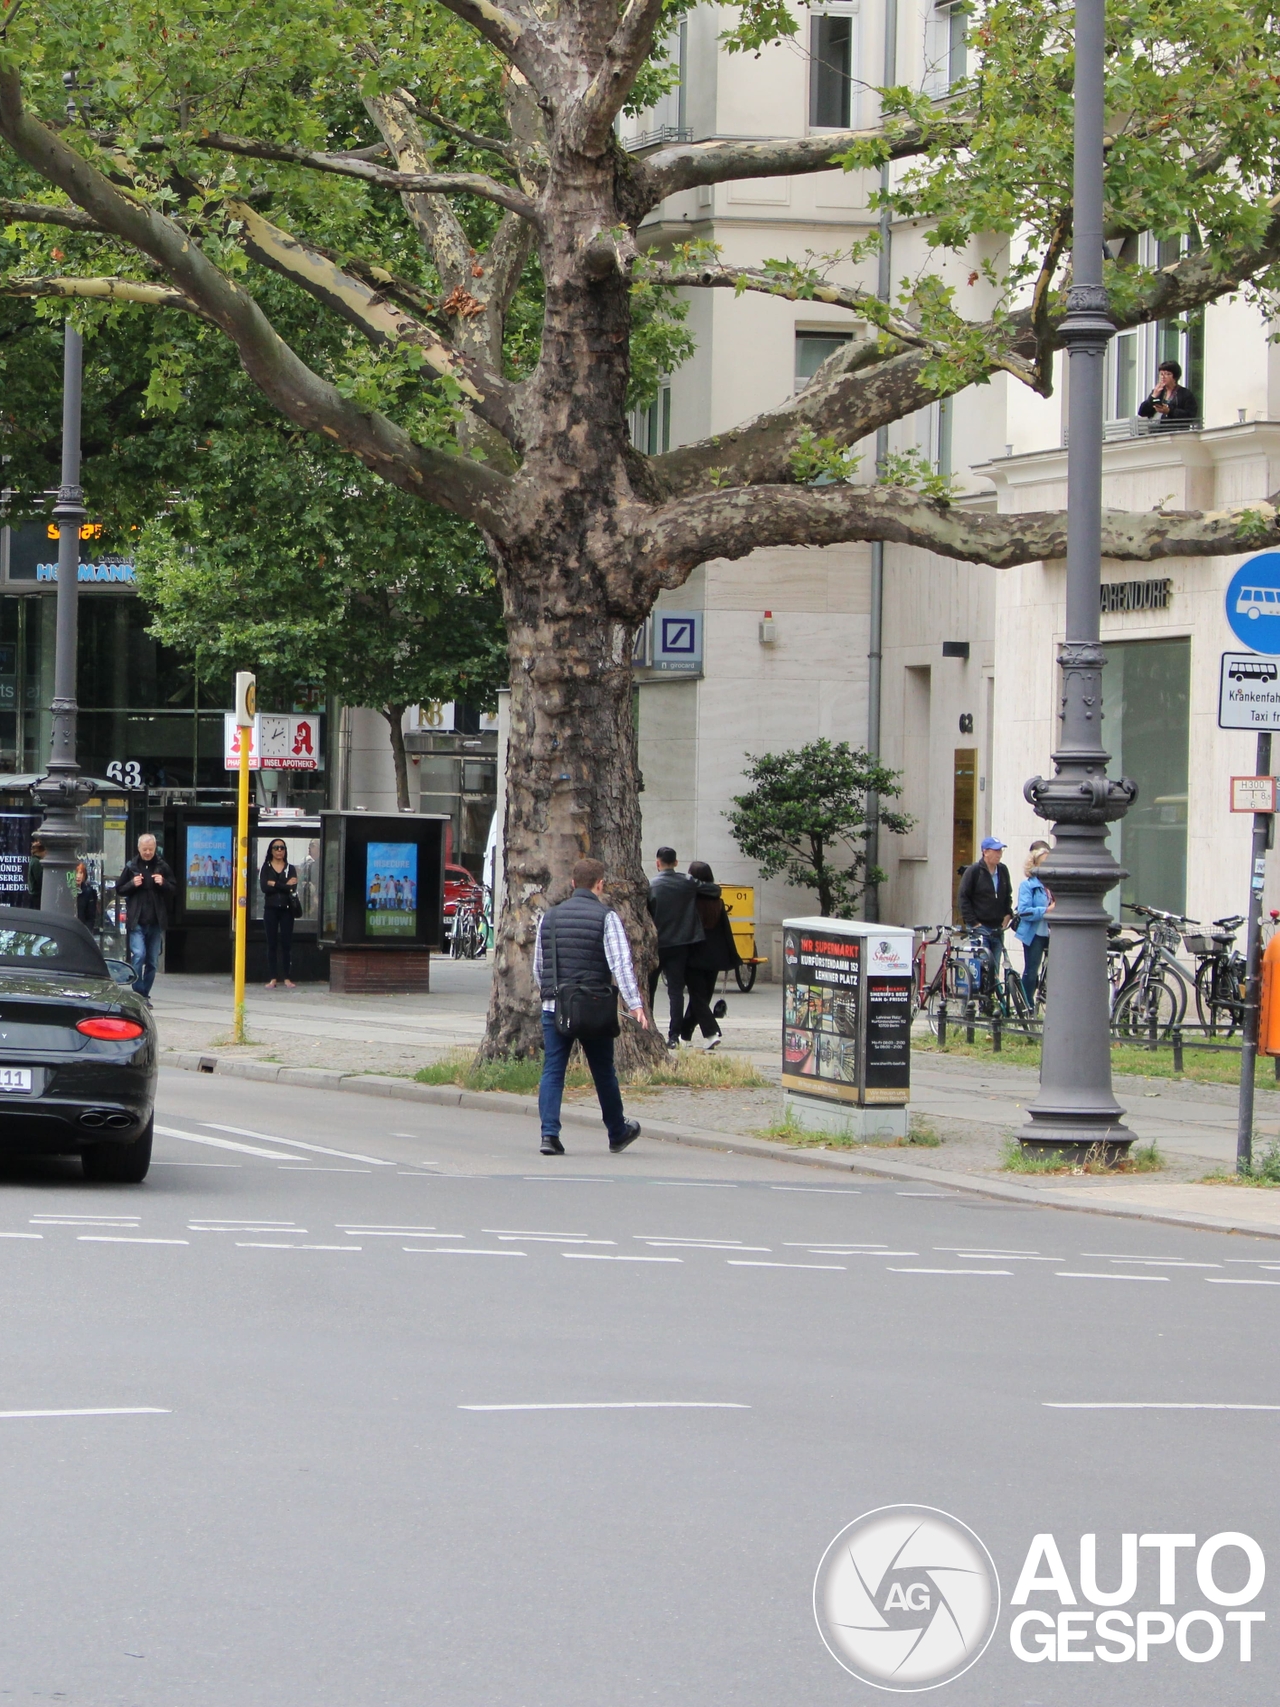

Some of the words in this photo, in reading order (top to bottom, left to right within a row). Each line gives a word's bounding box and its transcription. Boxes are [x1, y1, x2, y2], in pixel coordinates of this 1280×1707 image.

[36, 563, 138, 582] HMANN
[1251, 710, 1268, 721] Taxi
[264, 759, 281, 767] INSEL
[282, 759, 314, 768] APOTHEKE
[106, 761, 141, 787] 63
[736, 892, 747, 901] 01
[800, 938, 814, 953] IHR
[815, 940, 859, 959] SUPERMARKT
[800, 954, 850, 971] KURFÜRSTENDAMM
[850, 962, 859, 973] 152
[839, 973, 858, 986] PLATZ
